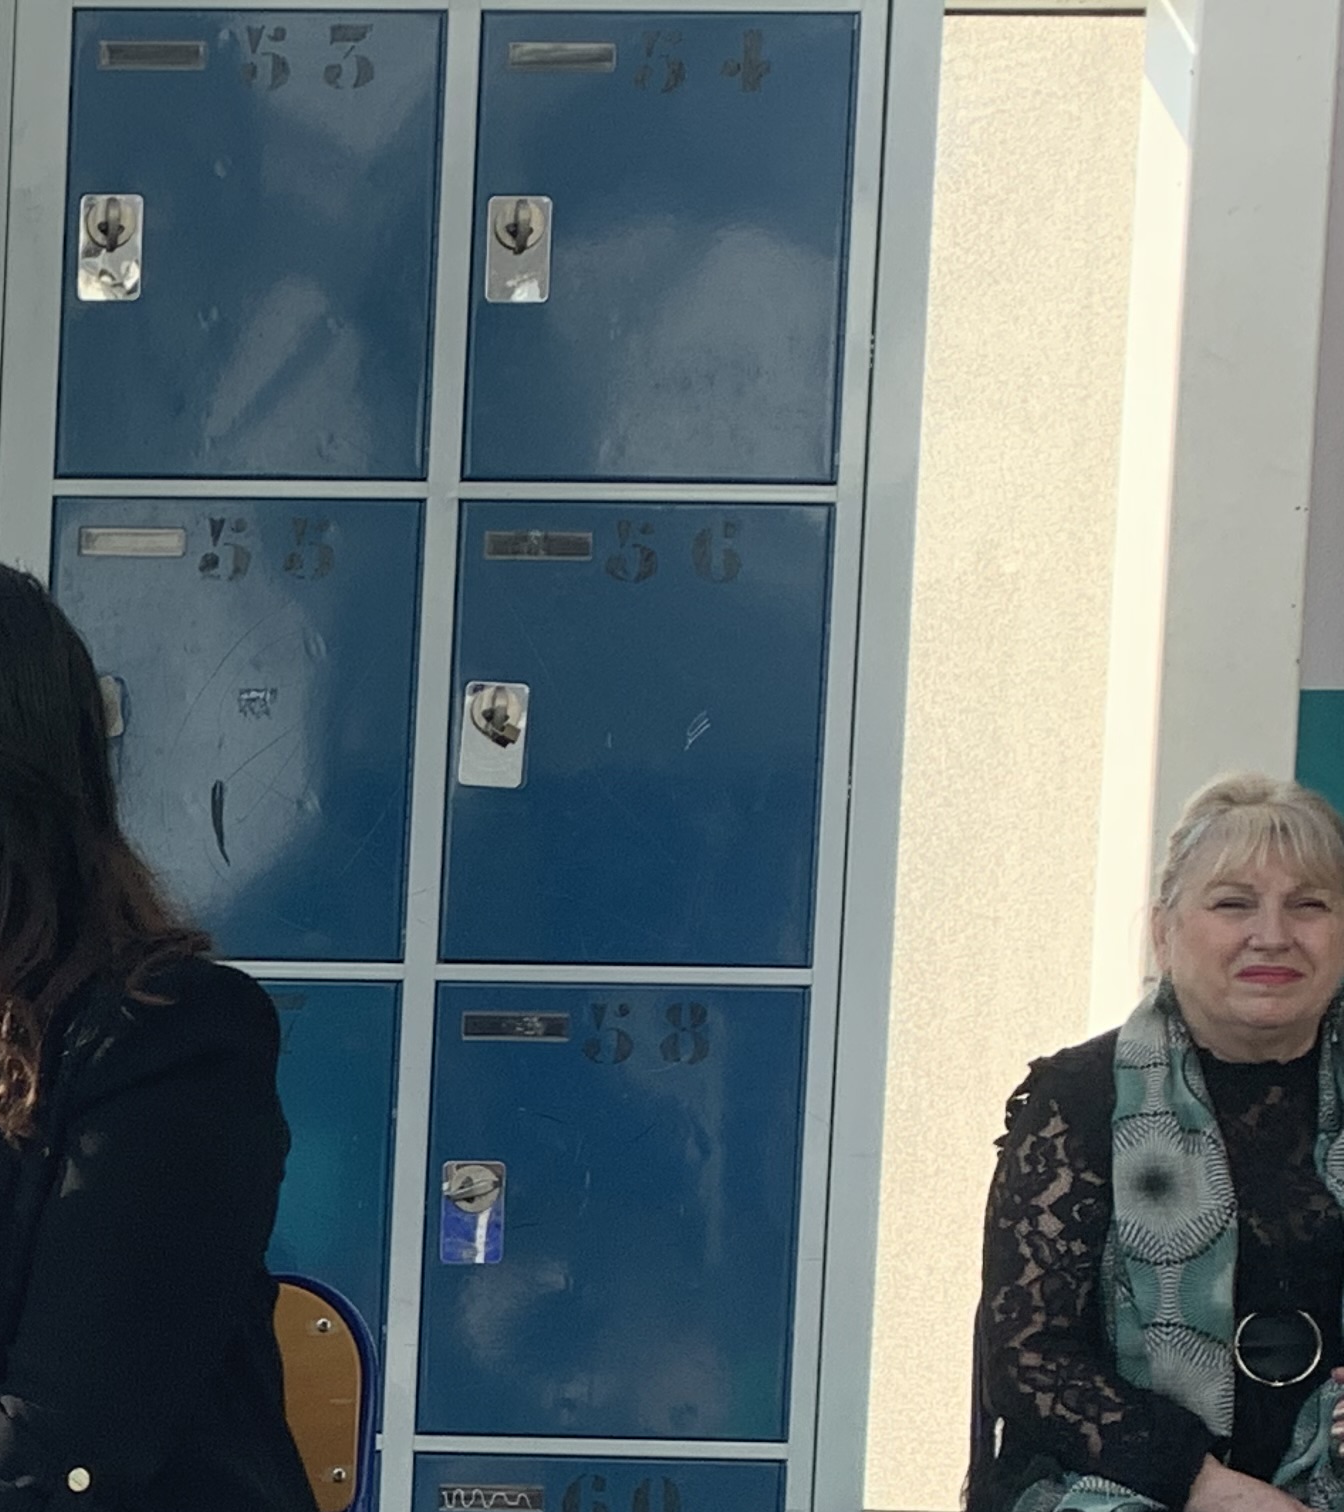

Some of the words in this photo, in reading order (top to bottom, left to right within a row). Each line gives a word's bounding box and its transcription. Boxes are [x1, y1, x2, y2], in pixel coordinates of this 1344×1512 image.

[238, 23, 375, 92] 53
[634, 29, 771, 93] 54
[605, 519, 743, 584] 56
[581, 1002, 711, 1064] 58
